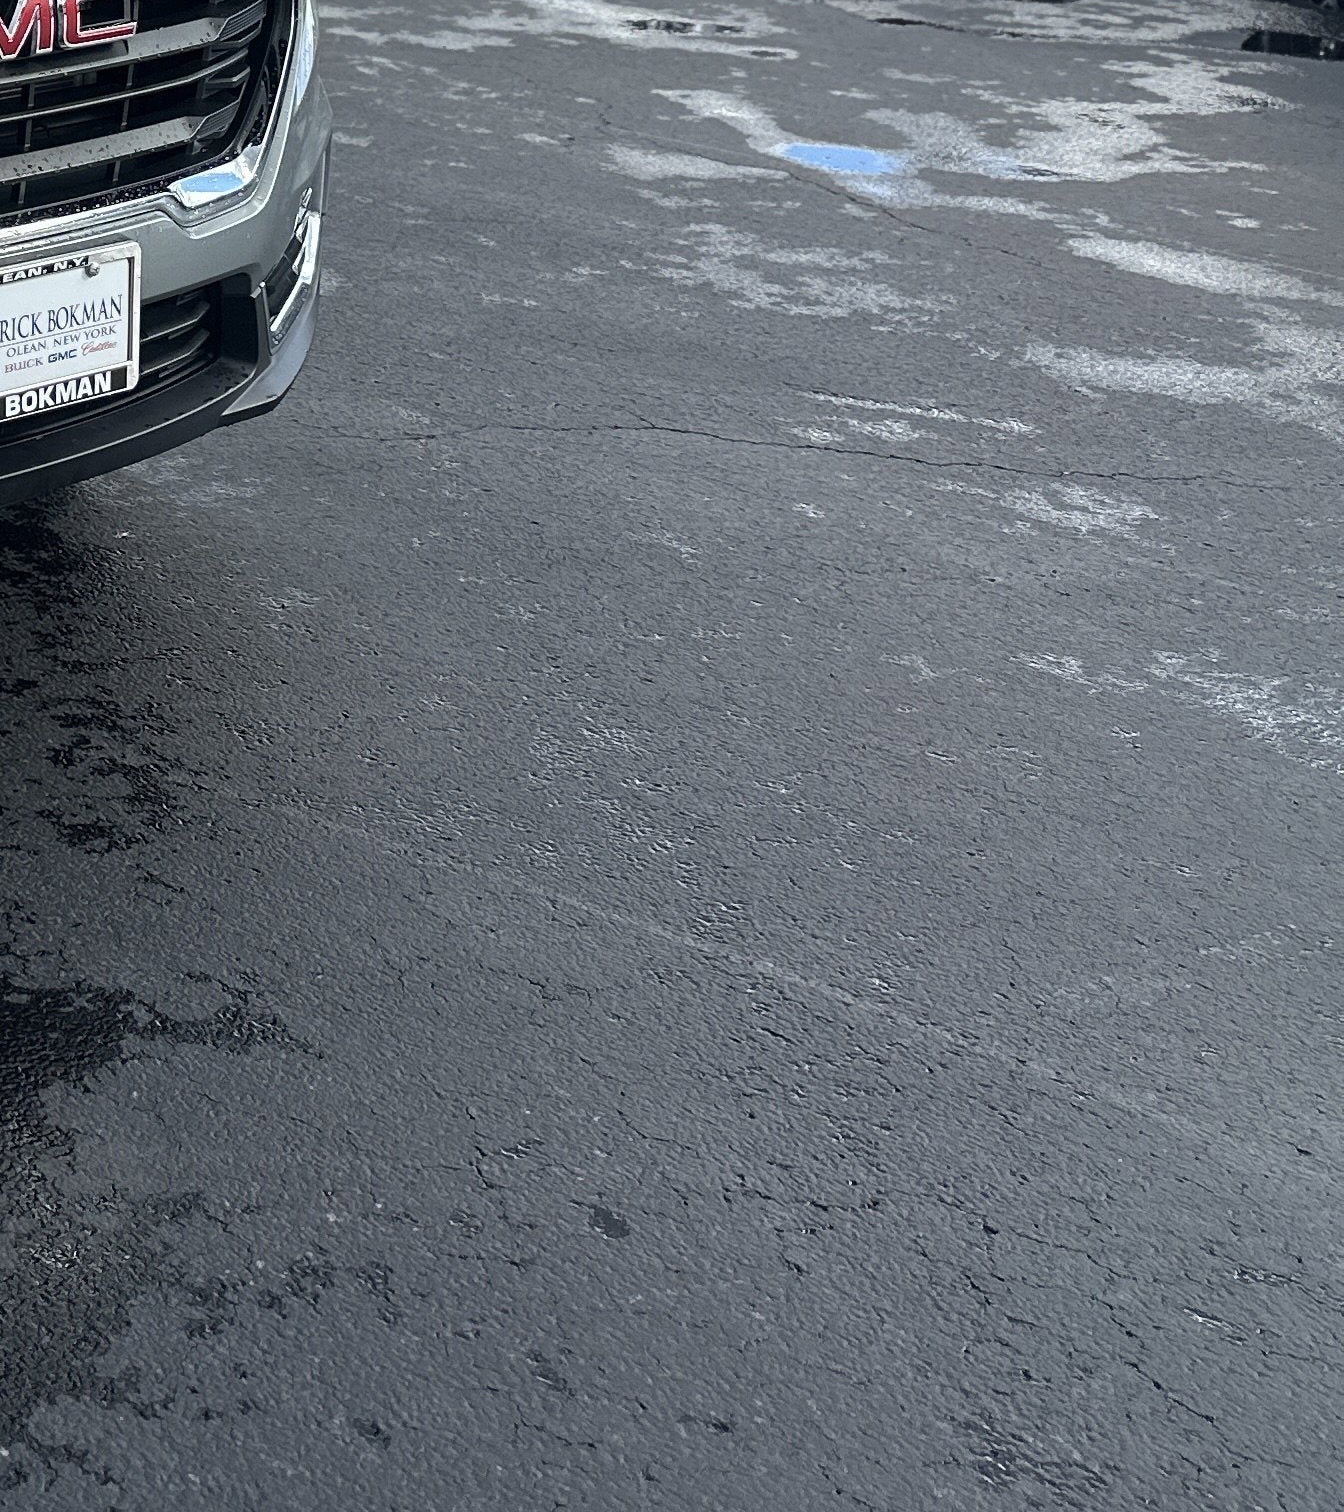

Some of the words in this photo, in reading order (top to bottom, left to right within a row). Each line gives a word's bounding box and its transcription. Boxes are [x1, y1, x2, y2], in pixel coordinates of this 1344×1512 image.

[0, 311, 43, 344] RICK
[47, 294, 122, 333] BOKMAN
[53, 332, 81, 348] NEW
[83, 324, 118, 341] YORK
[4, 356, 44, 374] BUICK
[47, 348, 78, 364] GMC
[5, 370, 112, 419] BOKMAN
